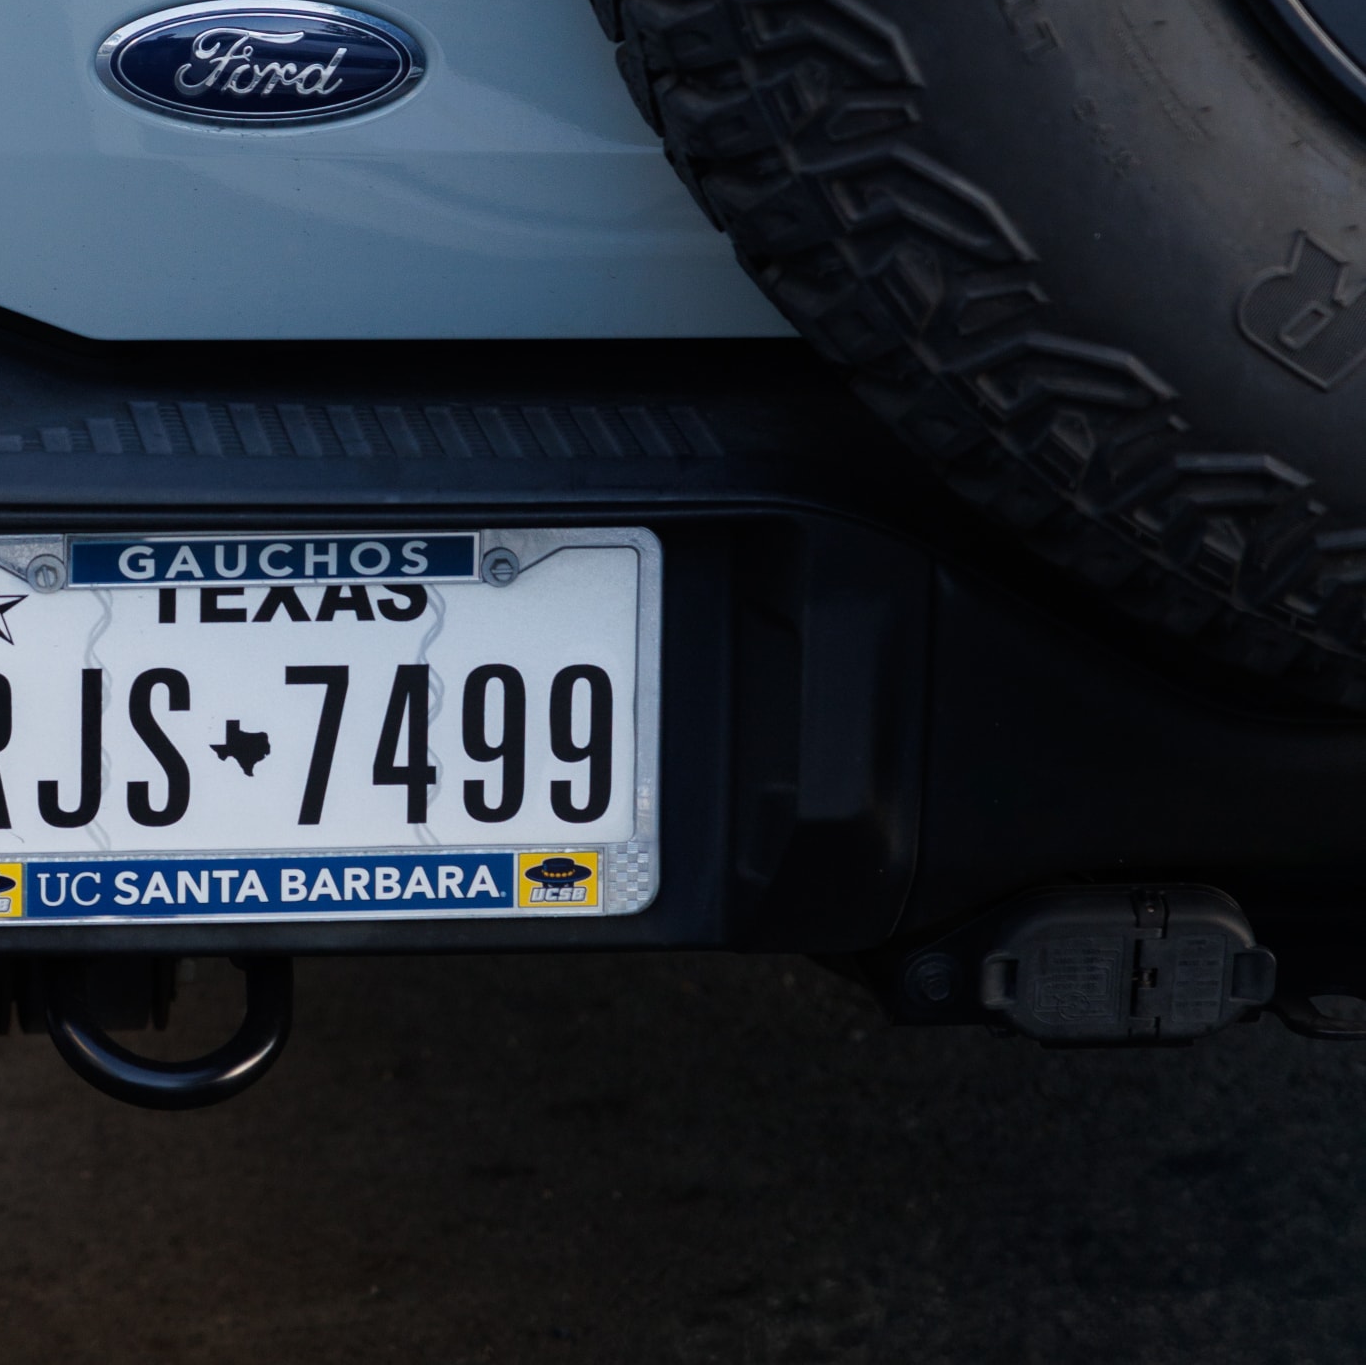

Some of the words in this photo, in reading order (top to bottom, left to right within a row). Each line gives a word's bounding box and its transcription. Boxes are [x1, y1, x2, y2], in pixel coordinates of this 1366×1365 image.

[175, 26, 348, 97] Ford
[118, 540, 429, 580] GAUCHOS
[284, 663, 615, 827] 7499
[37, 871, 102, 907] UC
[113, 869, 269, 907] SANTA
[280, 864, 501, 902] BARBARA
[528, 886, 588, 903] UCSB
